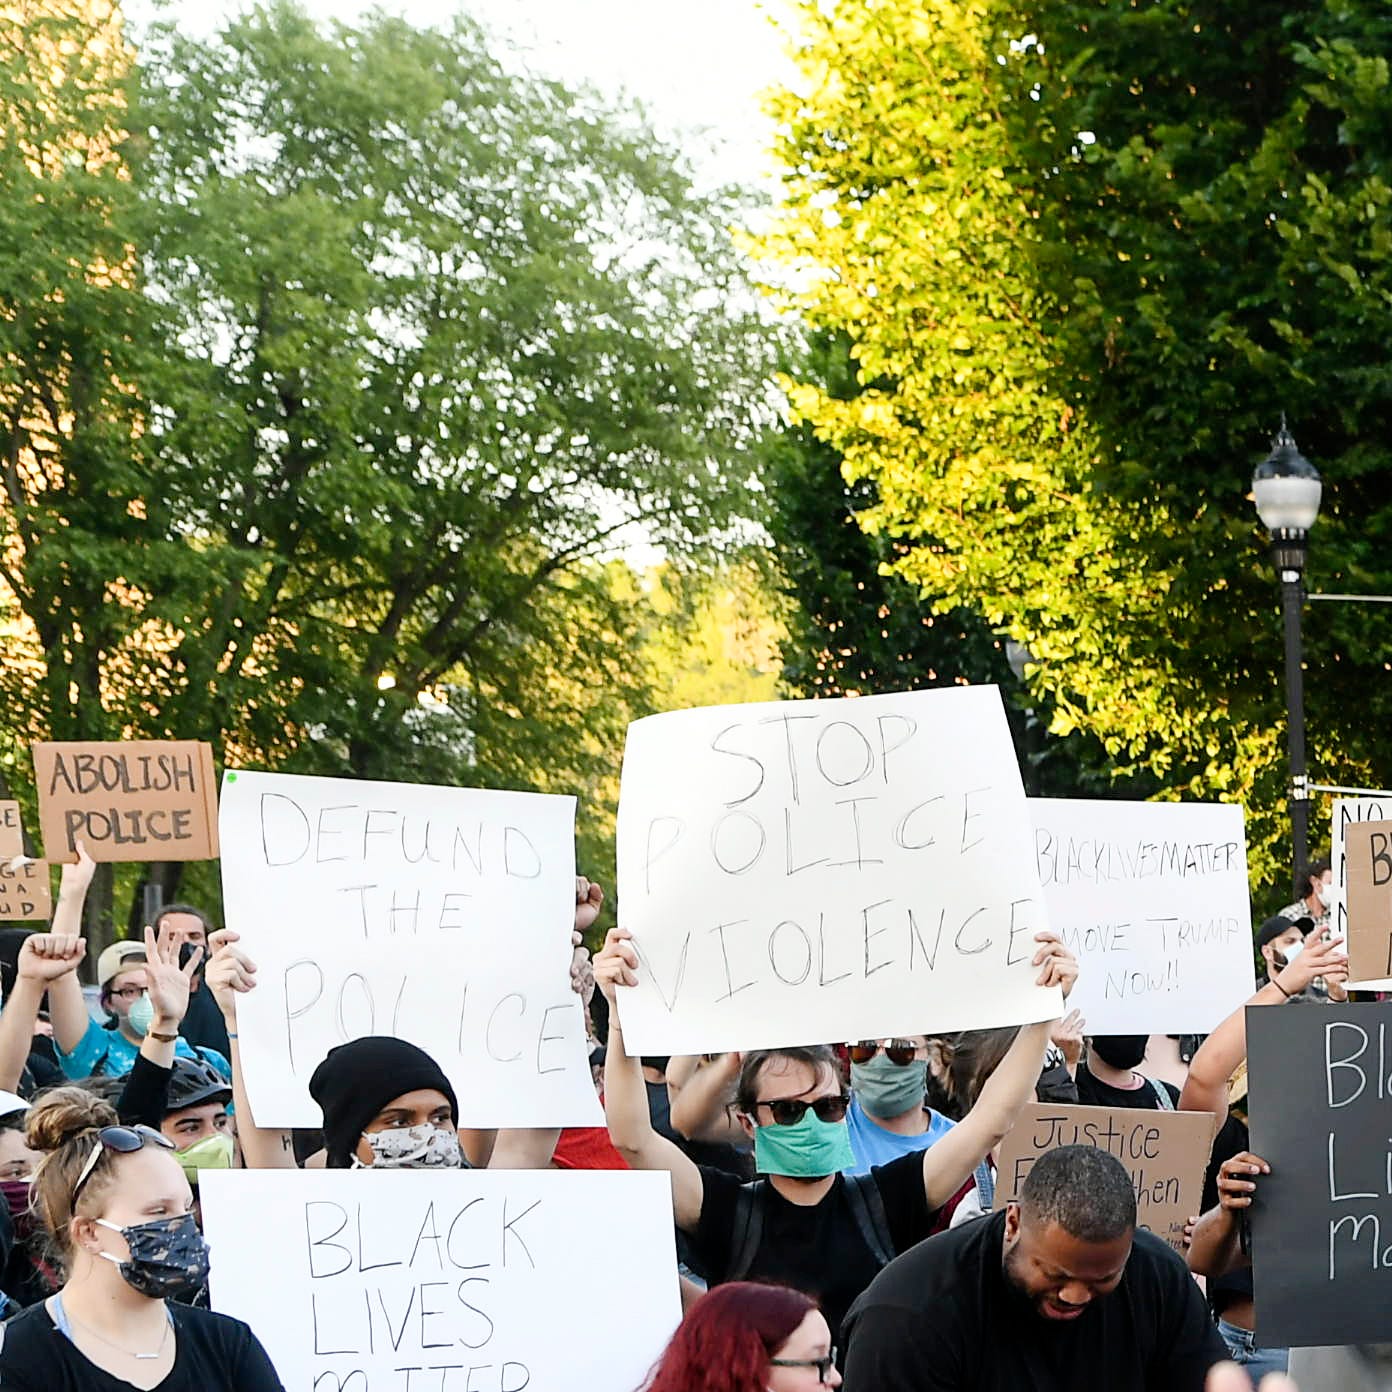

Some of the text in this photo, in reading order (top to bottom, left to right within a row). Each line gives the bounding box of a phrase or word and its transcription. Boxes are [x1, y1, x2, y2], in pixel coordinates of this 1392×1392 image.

[50, 752, 196, 796] ABOLISH
[711, 711, 918, 809] STOP
[64, 808, 193, 853] POLICE
[261, 793, 542, 880] DEFUND
[646, 787, 993, 895] POLICE
[337, 884, 472, 939] THE
[1060, 917, 1239, 956] MOVE TRUMP
[630, 898, 1033, 1014] VIOLENCE
[1105, 959, 1180, 1000] NOW!!
[283, 960, 575, 1074] POLICE
[1033, 1116, 1160, 1160] Justice
[304, 1197, 542, 1279] BLACK
[311, 1277, 494, 1356] LIVES
